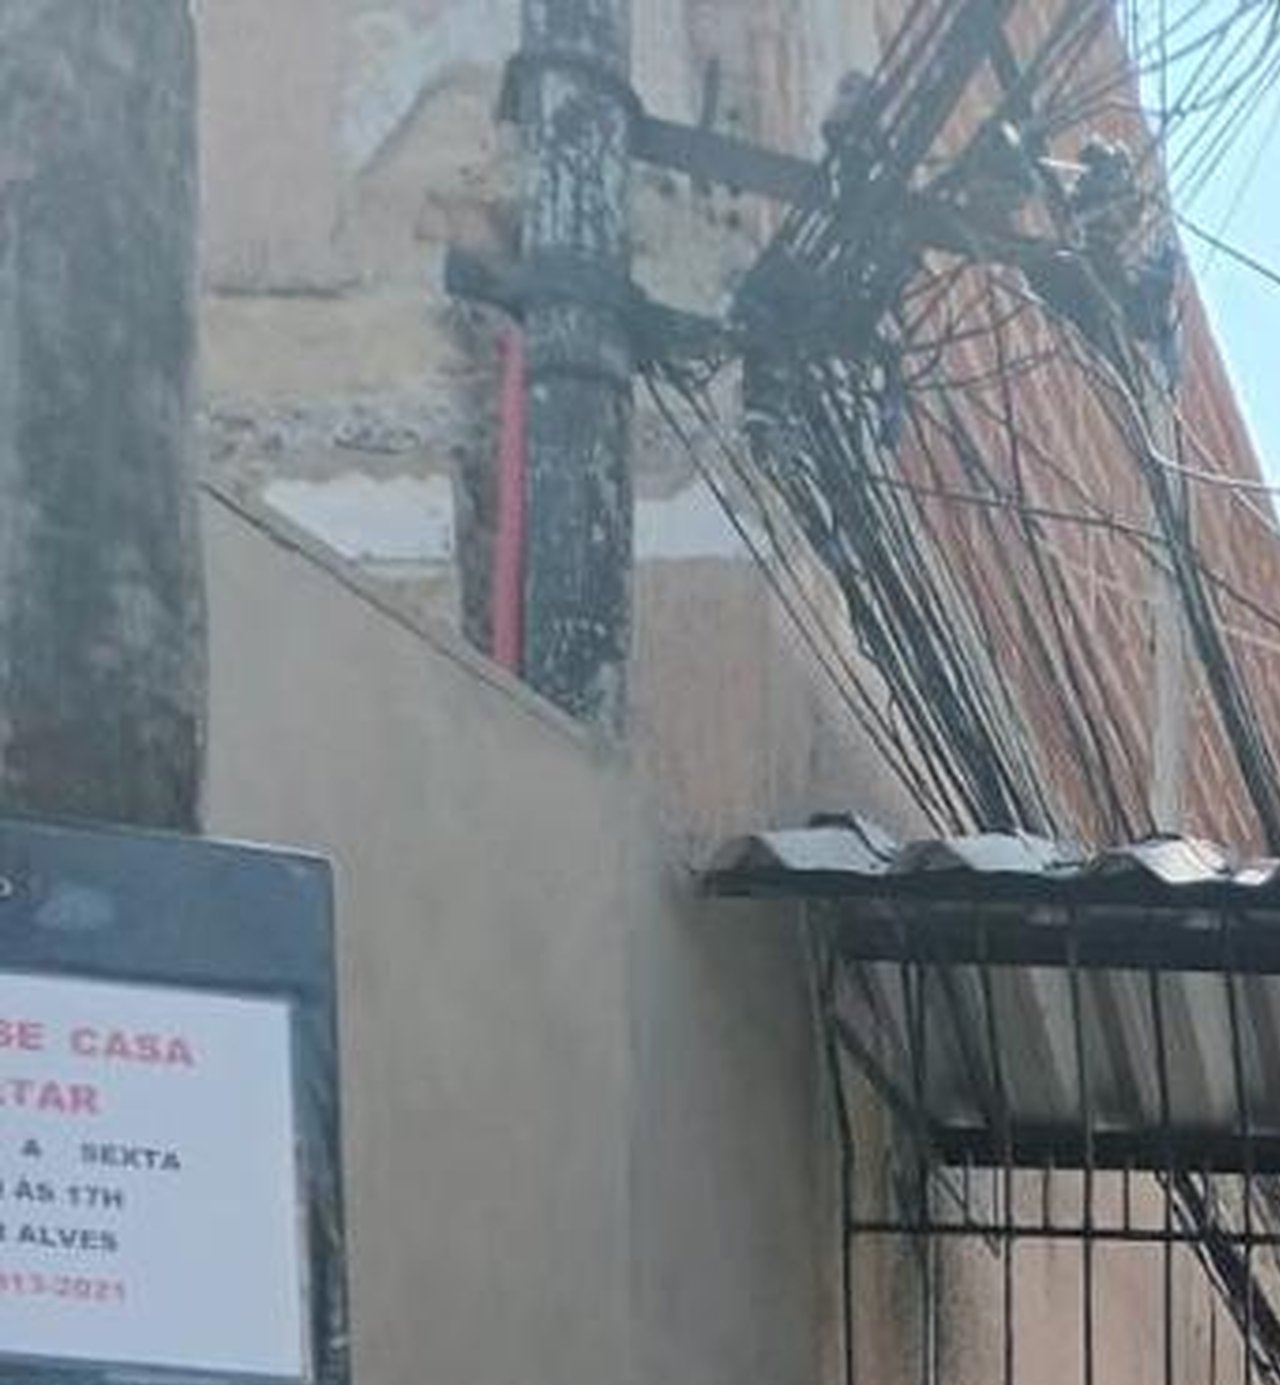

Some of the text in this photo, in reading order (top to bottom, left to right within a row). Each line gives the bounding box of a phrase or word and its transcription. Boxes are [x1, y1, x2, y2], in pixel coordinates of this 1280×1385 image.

[70, 1026, 195, 1068] CASA
[0, 1079, 101, 1115] TAR
[21, 1138, 181, 1171] A SEXTA
[18, 1223, 119, 1252] ALVES
